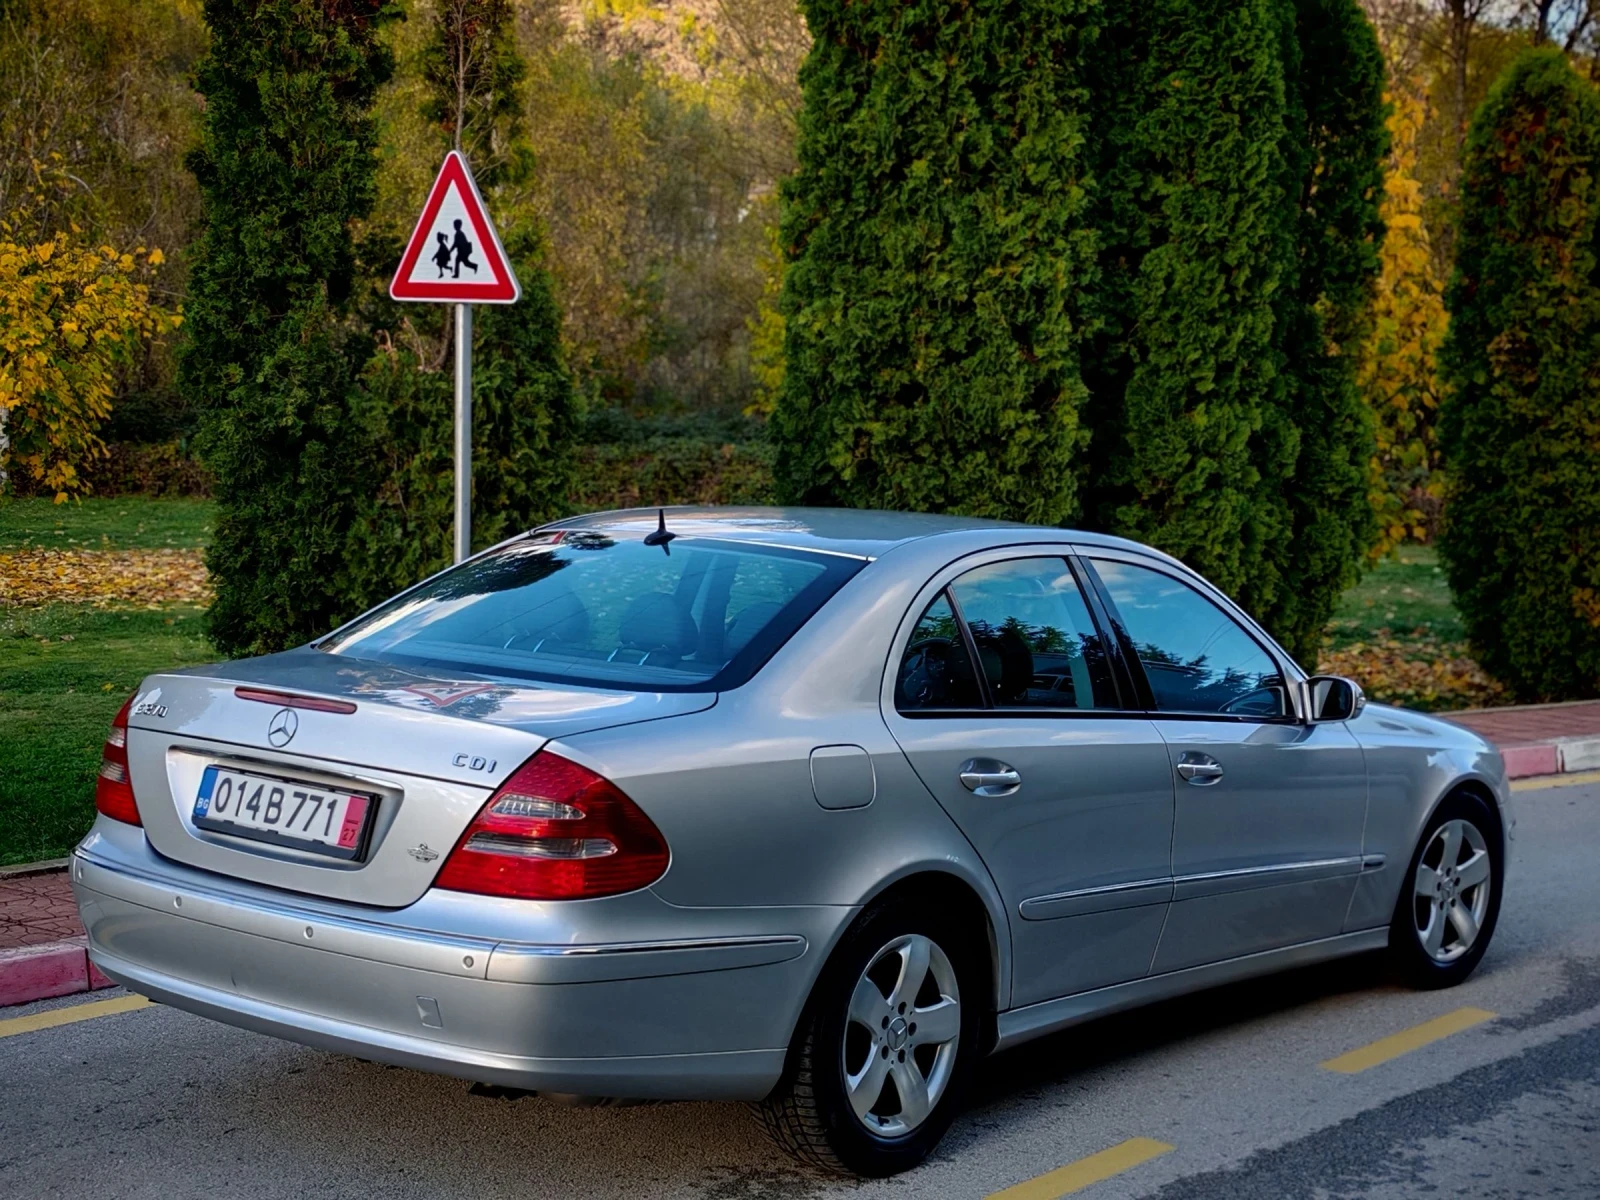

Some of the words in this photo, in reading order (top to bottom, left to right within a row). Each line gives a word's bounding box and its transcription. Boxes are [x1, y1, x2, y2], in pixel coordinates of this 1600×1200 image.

[452, 752, 498, 774] CDI
[196, 797, 210, 810] BG
[214, 777, 339, 836] 014B771
